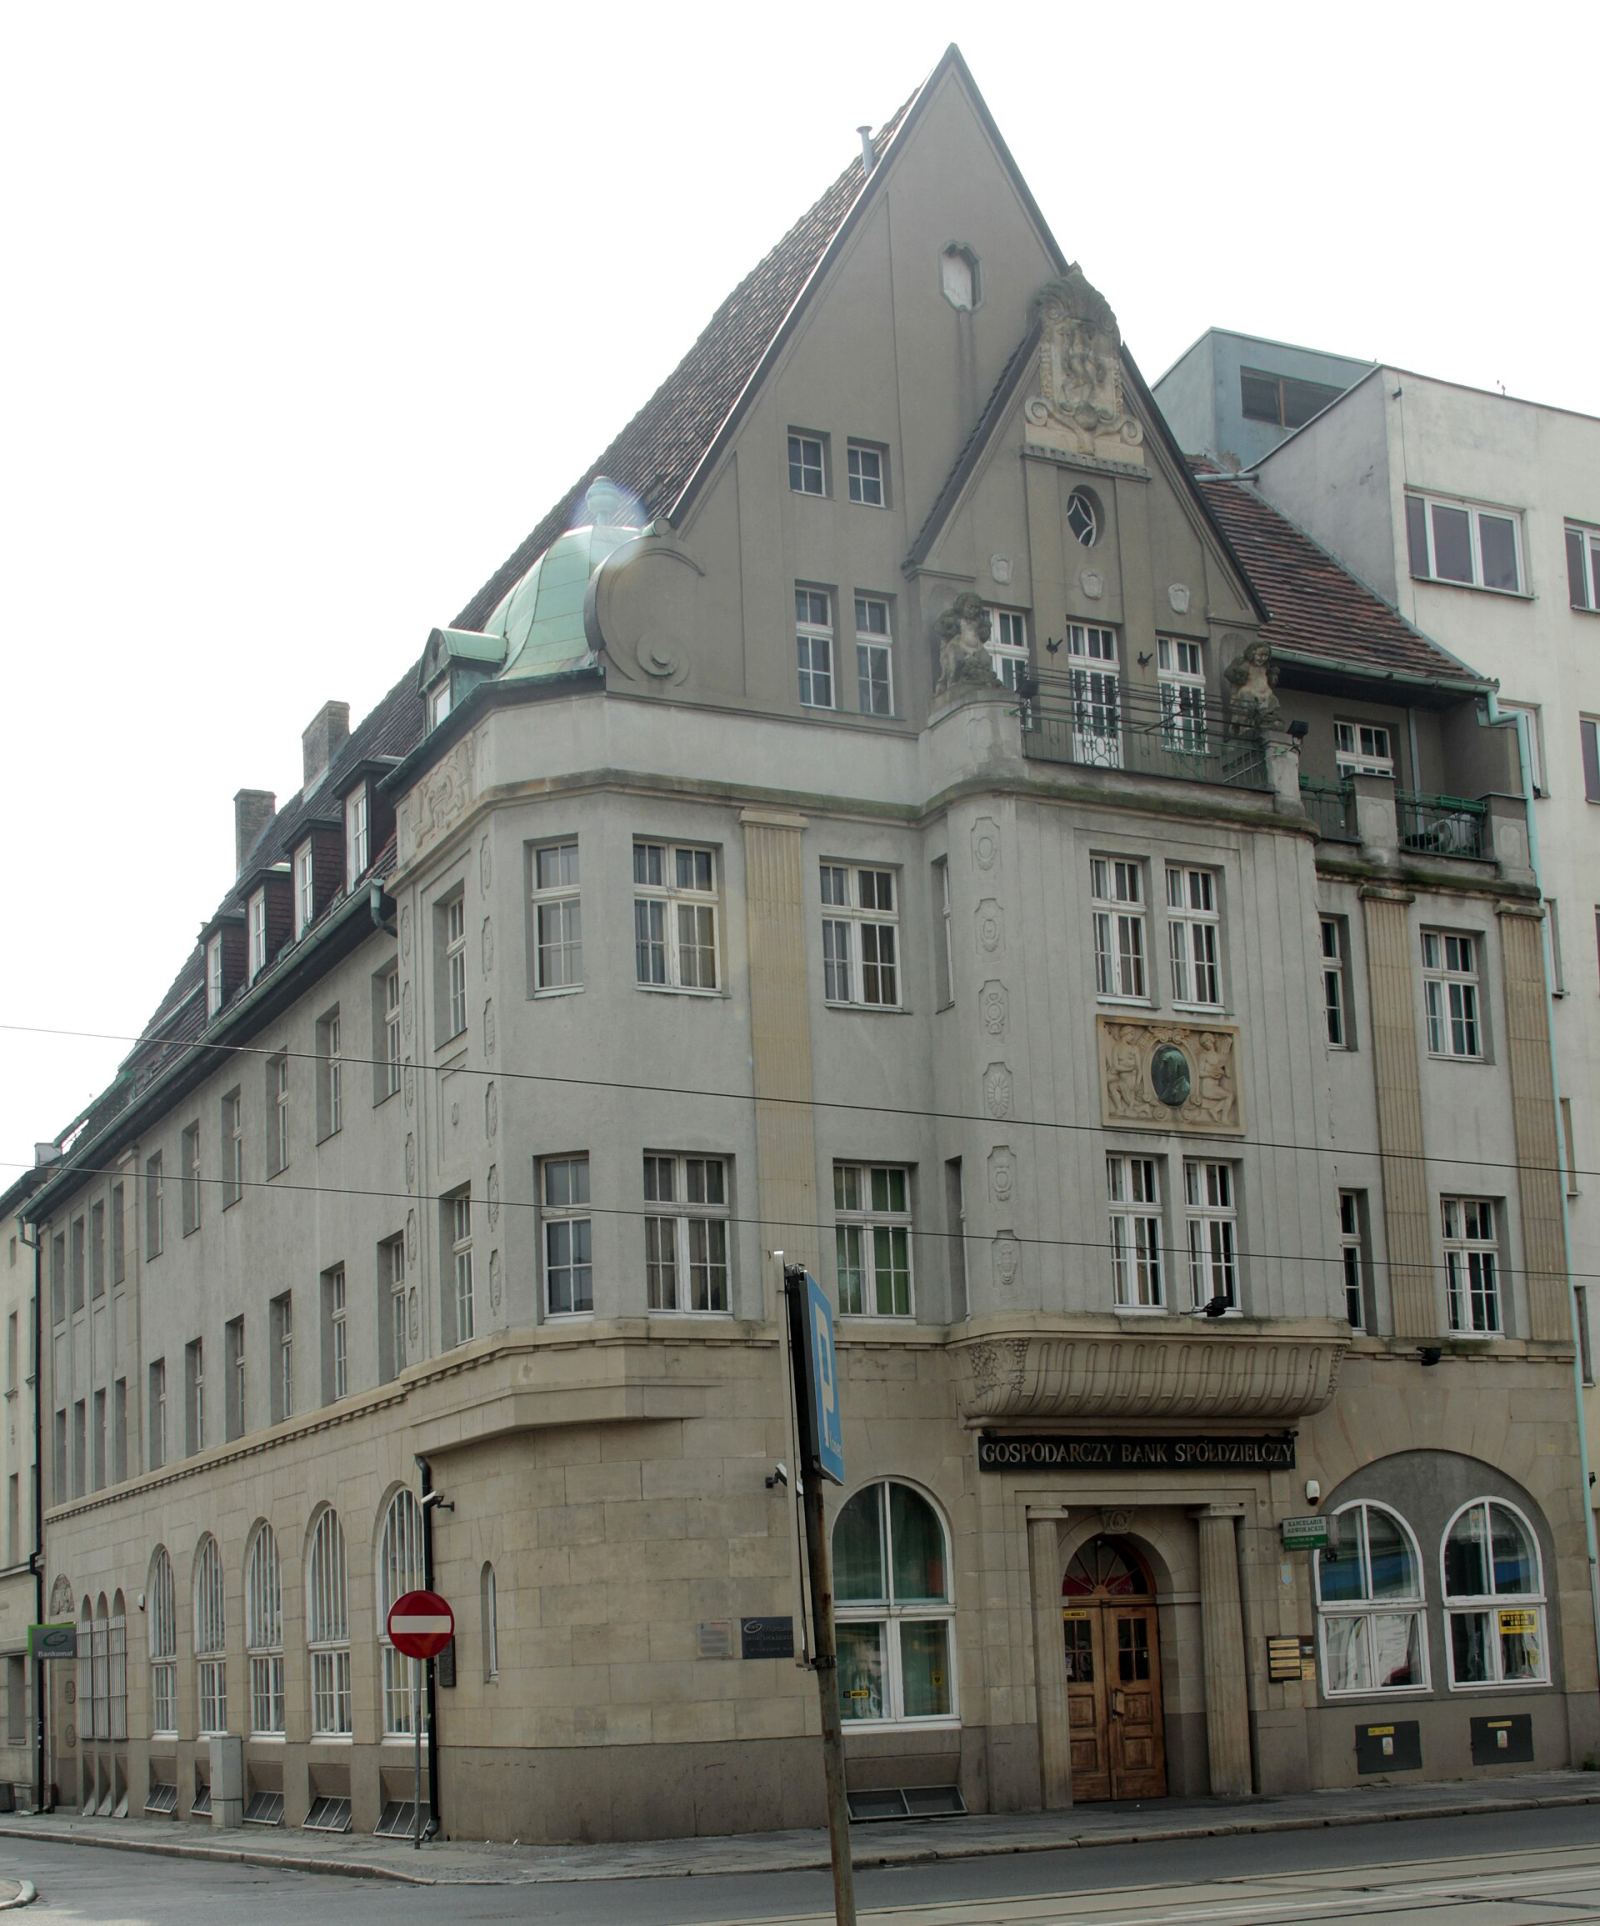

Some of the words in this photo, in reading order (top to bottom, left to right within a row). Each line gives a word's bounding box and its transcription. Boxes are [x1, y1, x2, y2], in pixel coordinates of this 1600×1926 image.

[981, 1443, 1114, 1463] GOSPODARCZY
[1121, 1443, 1168, 1463] BANK
[1175, 1440, 1294, 1463] SPÓŁDZIELCZY
